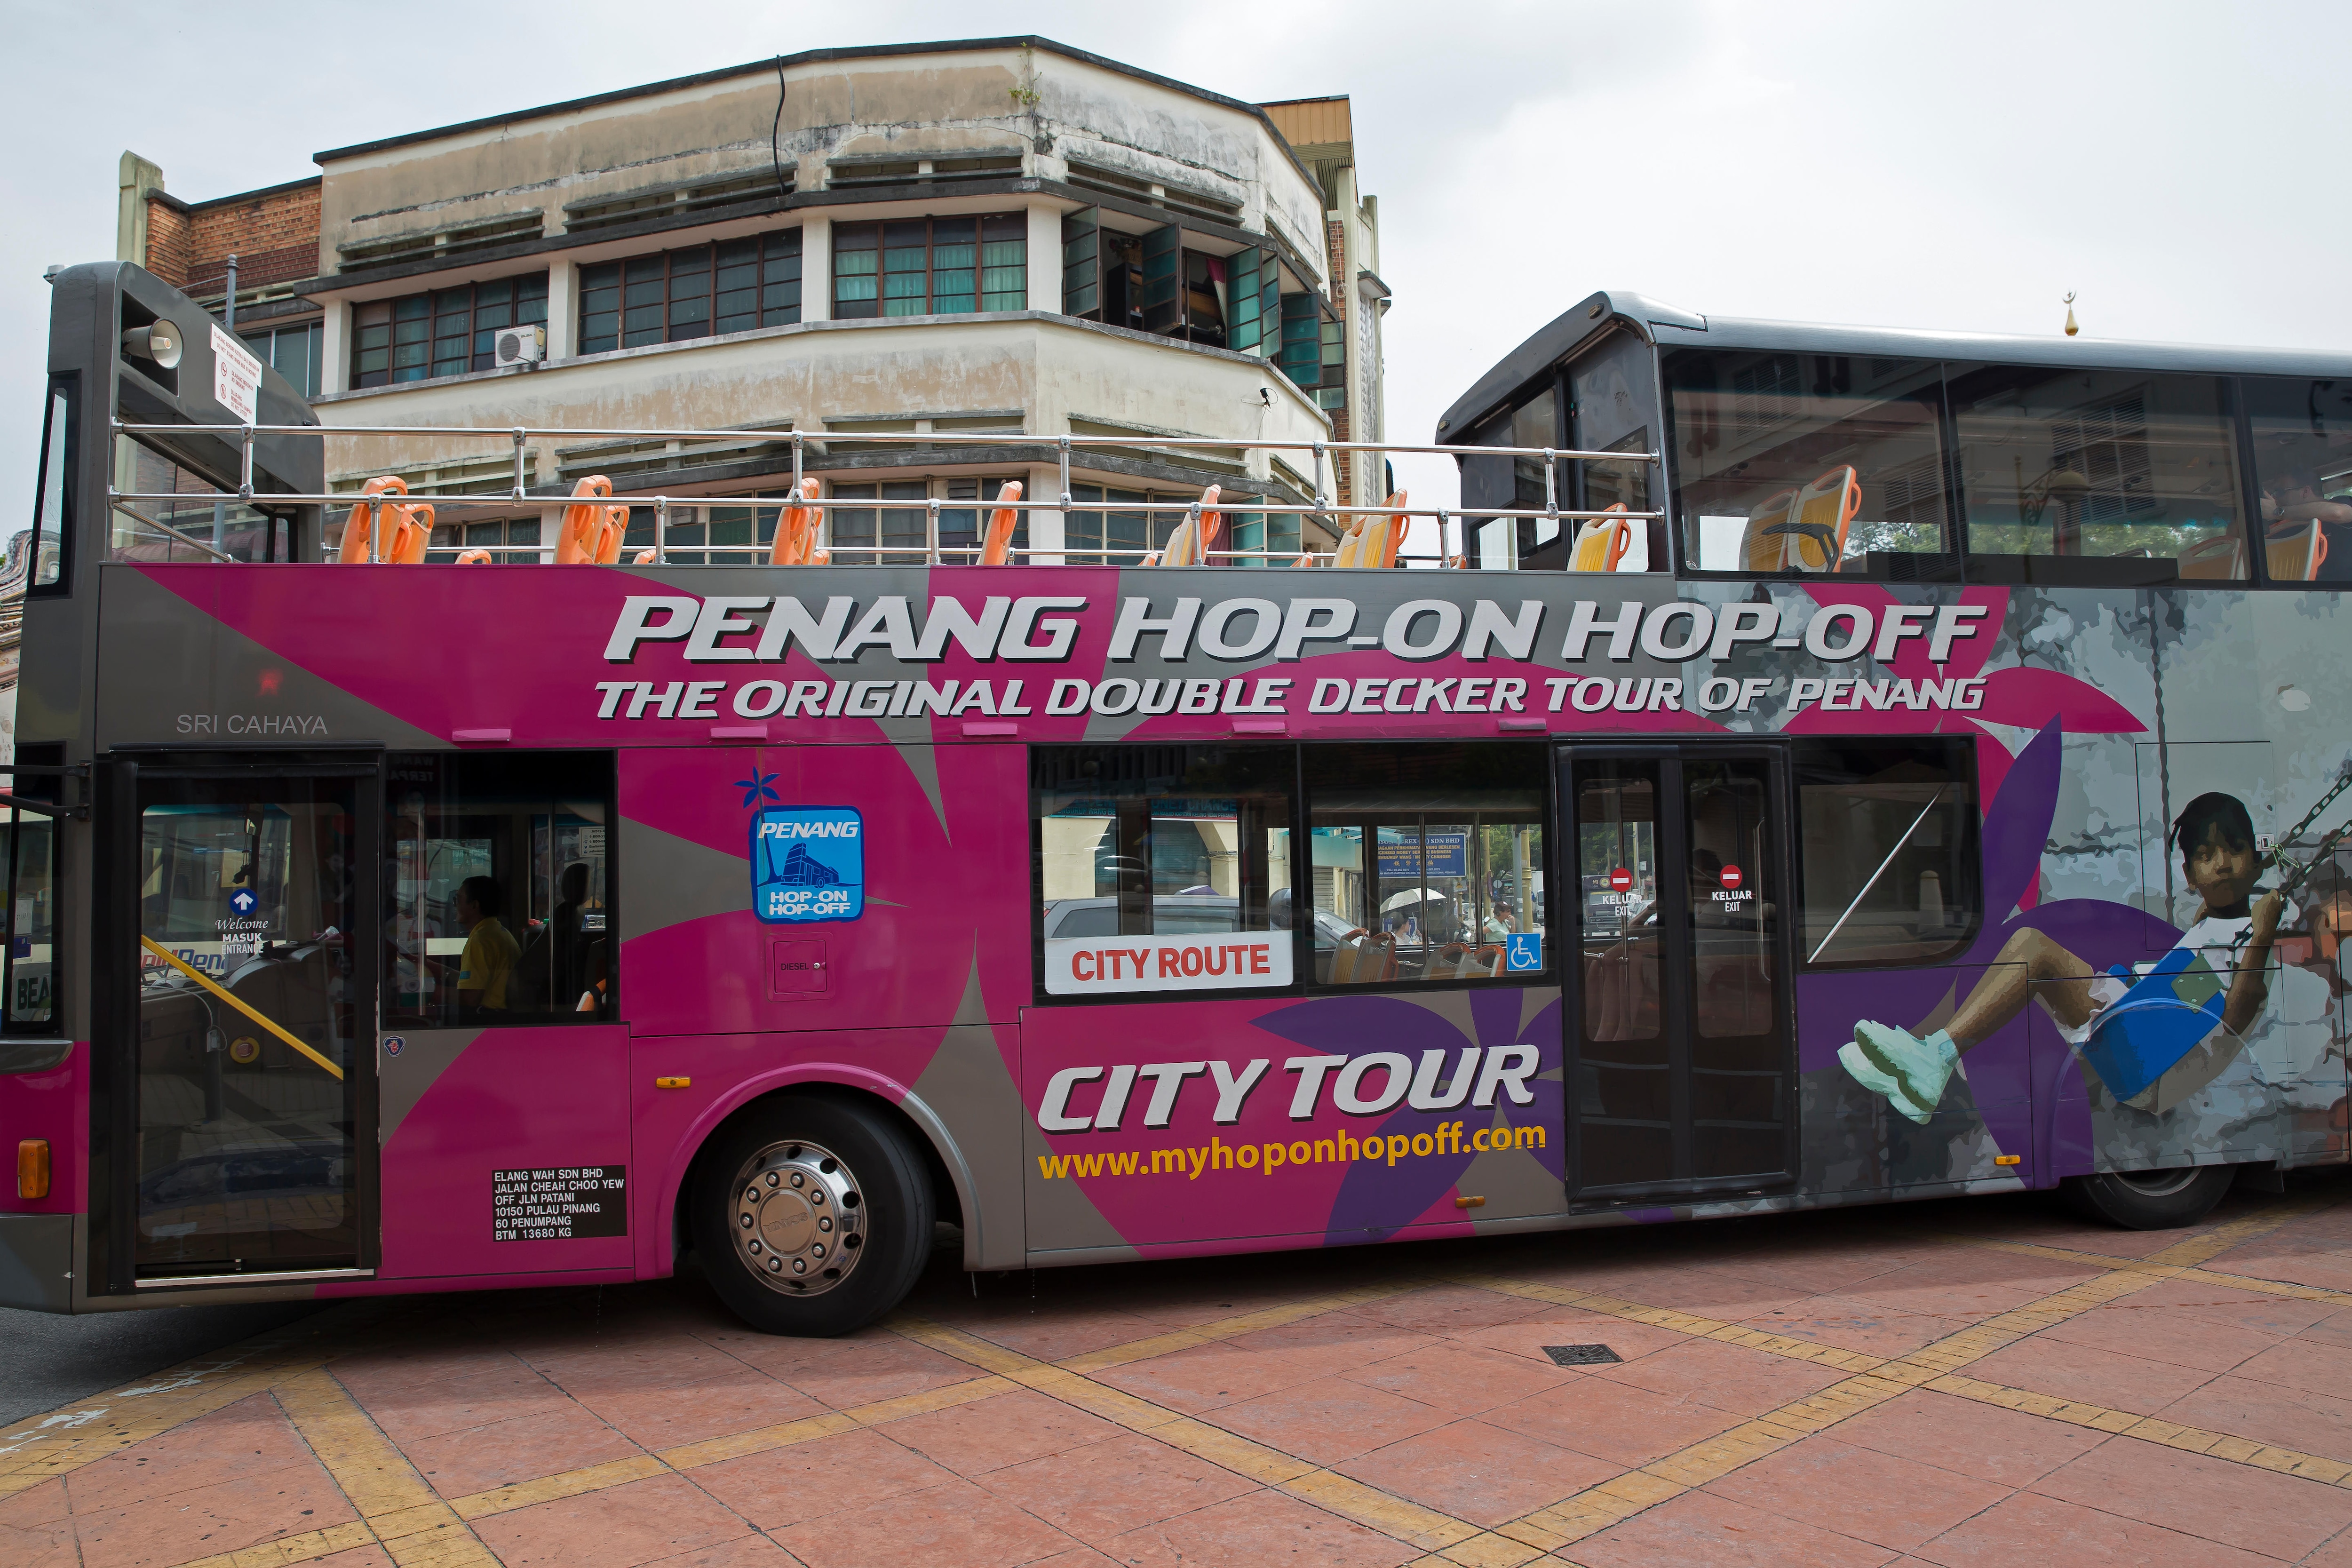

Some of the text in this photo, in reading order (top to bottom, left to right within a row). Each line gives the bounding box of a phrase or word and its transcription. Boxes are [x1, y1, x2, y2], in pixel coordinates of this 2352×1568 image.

[232, 370, 243, 383] DILARANG
[235, 380, 245, 391] SMOKING
[231, 389, 242, 401] DILARANG
[604, 596, 1991, 664] PENANG HOP-ON HOP-OFF
[595, 677, 1989, 720] THE ORIGINAL DOUBLE DECKER TOUR OF PENANG
[176, 714, 328, 734] SRI CAHAYA
[758, 821, 859, 838] PENANG
[771, 891, 847, 902] HOP-ON
[1602, 895, 1642, 905] KELUAR
[1712, 890, 1752, 901] KELUAR
[769, 902, 851, 915] HOP-OFF
[1615, 906, 1630, 916] EXIT
[1724, 901, 1740, 912] EXIT
[215, 917, 269, 930] Welcome
[222, 932, 262, 942] MASUK
[222, 943, 264, 954] ENTRANCE
[781, 963, 809, 971] DIESEL
[1072, 944, 1270, 981] CITY ROUTE
[1037, 1044, 1543, 1134] CITY TOUR
[1038, 1121, 1546, 1180] www.myhoponhopoff.com
[494, 1168, 603, 1182] ELANG WAH SDN BHD
[495, 1179, 624, 1194] JALAN CHEAH CHOO YEW
[495, 1193, 575, 1205] OFF JLN PATANI
[495, 1203, 600, 1217] 10150 PULAU PINANG
[495, 1216, 572, 1228] 60 PENUMPANG
[496, 1227, 572, 1241] BTM 13680 KG
